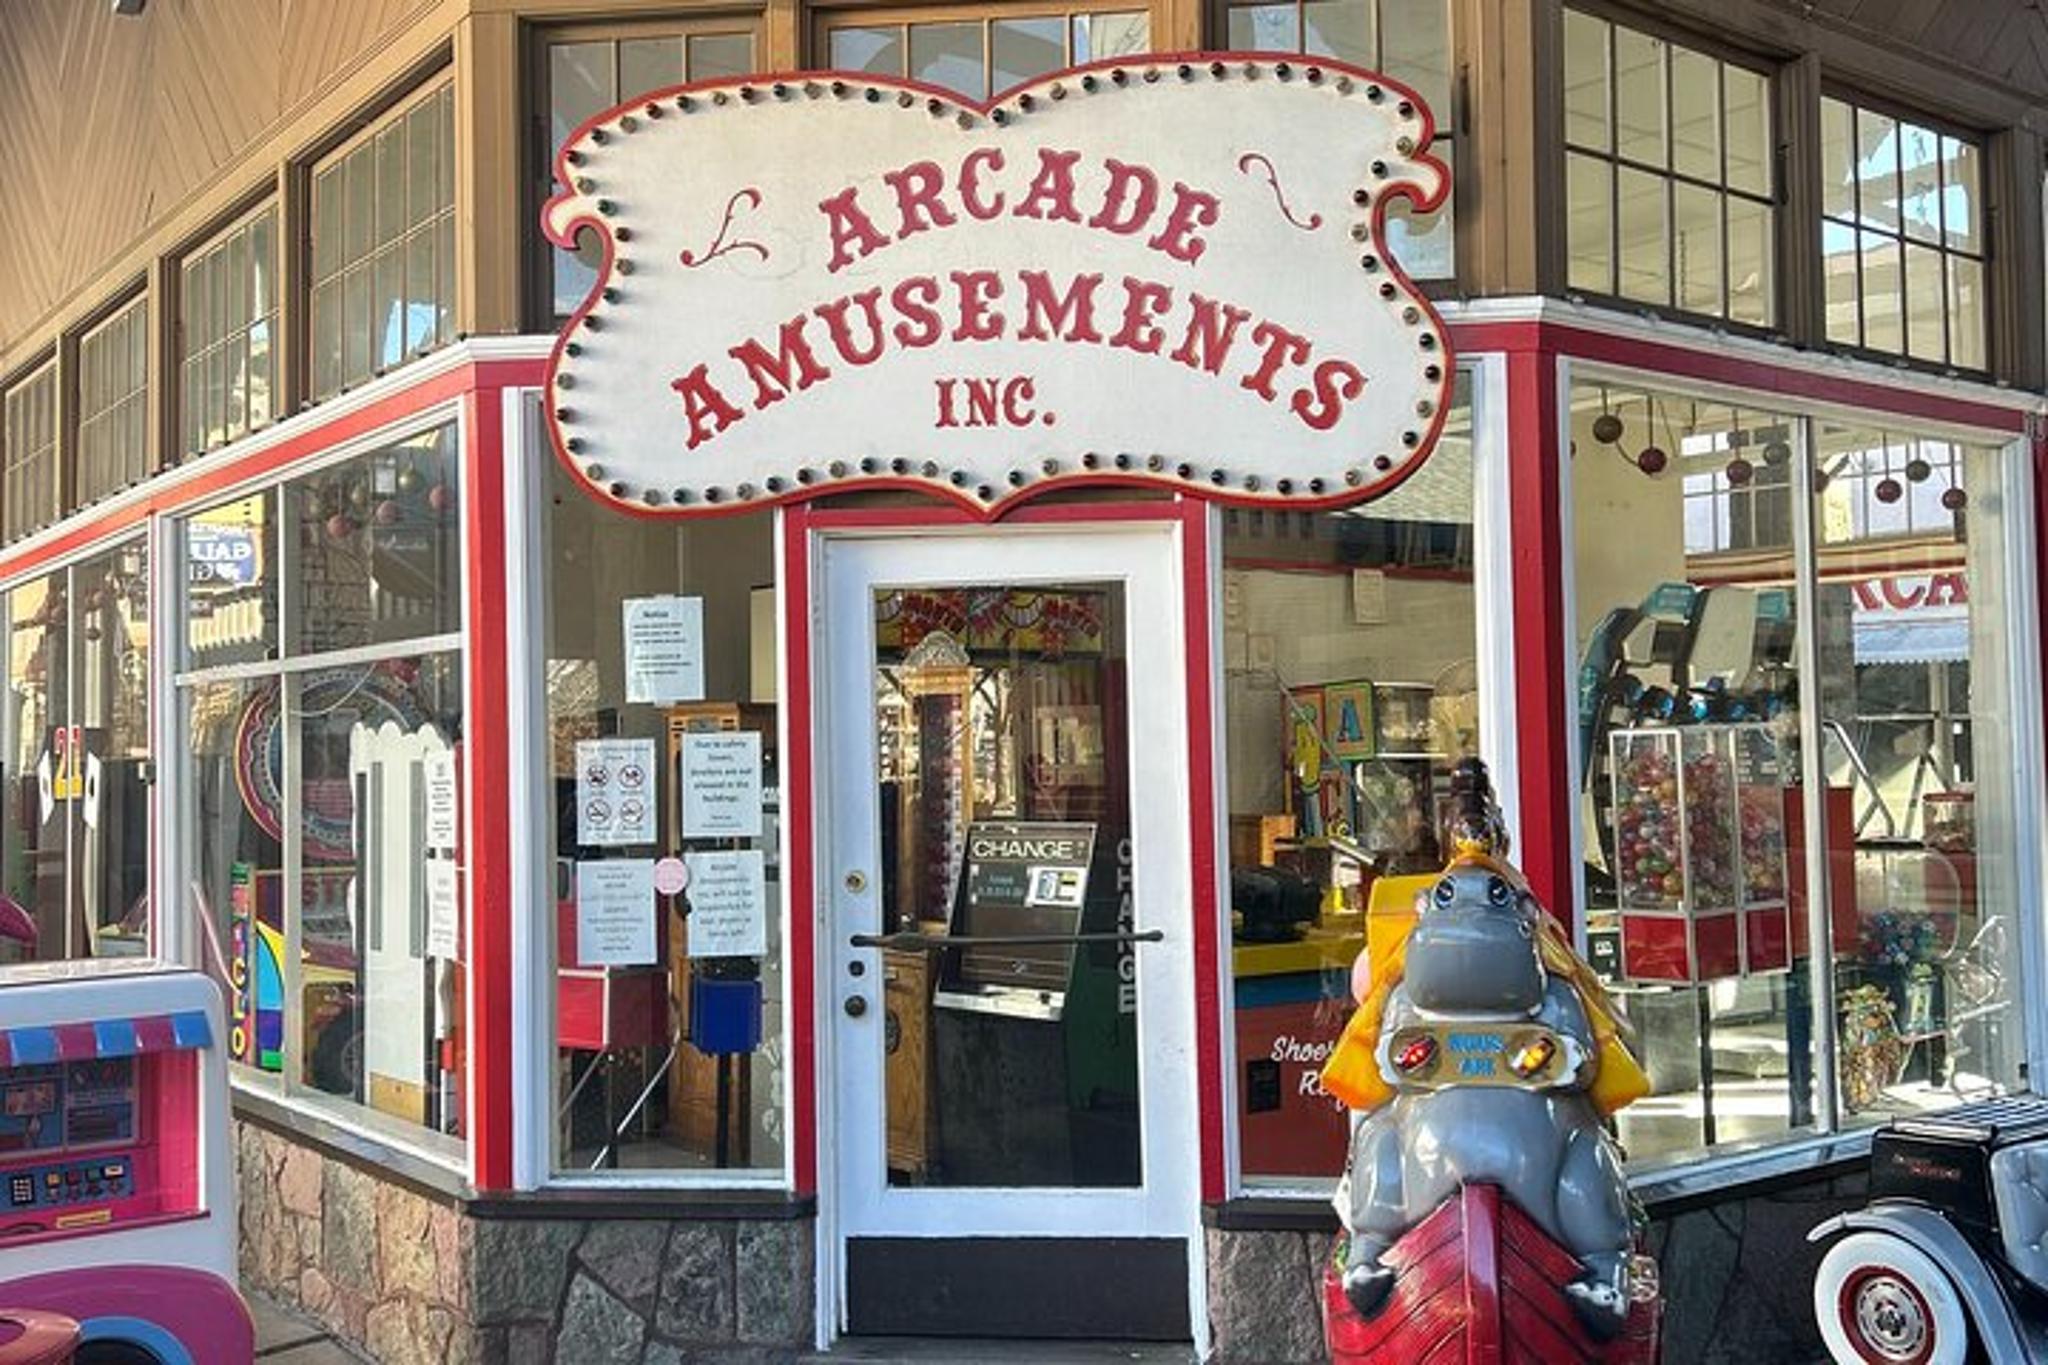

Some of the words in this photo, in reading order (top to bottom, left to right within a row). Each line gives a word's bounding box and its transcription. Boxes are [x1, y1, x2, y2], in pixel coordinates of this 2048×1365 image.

[818, 146, 1222, 274] ARCADE
[671, 270, 1369, 450] AMUSEMENTS
[934, 376, 1056, 428] INC.
[974, 840, 1073, 858] CHANGE
[1116, 837, 1137, 1013] CHANGE
